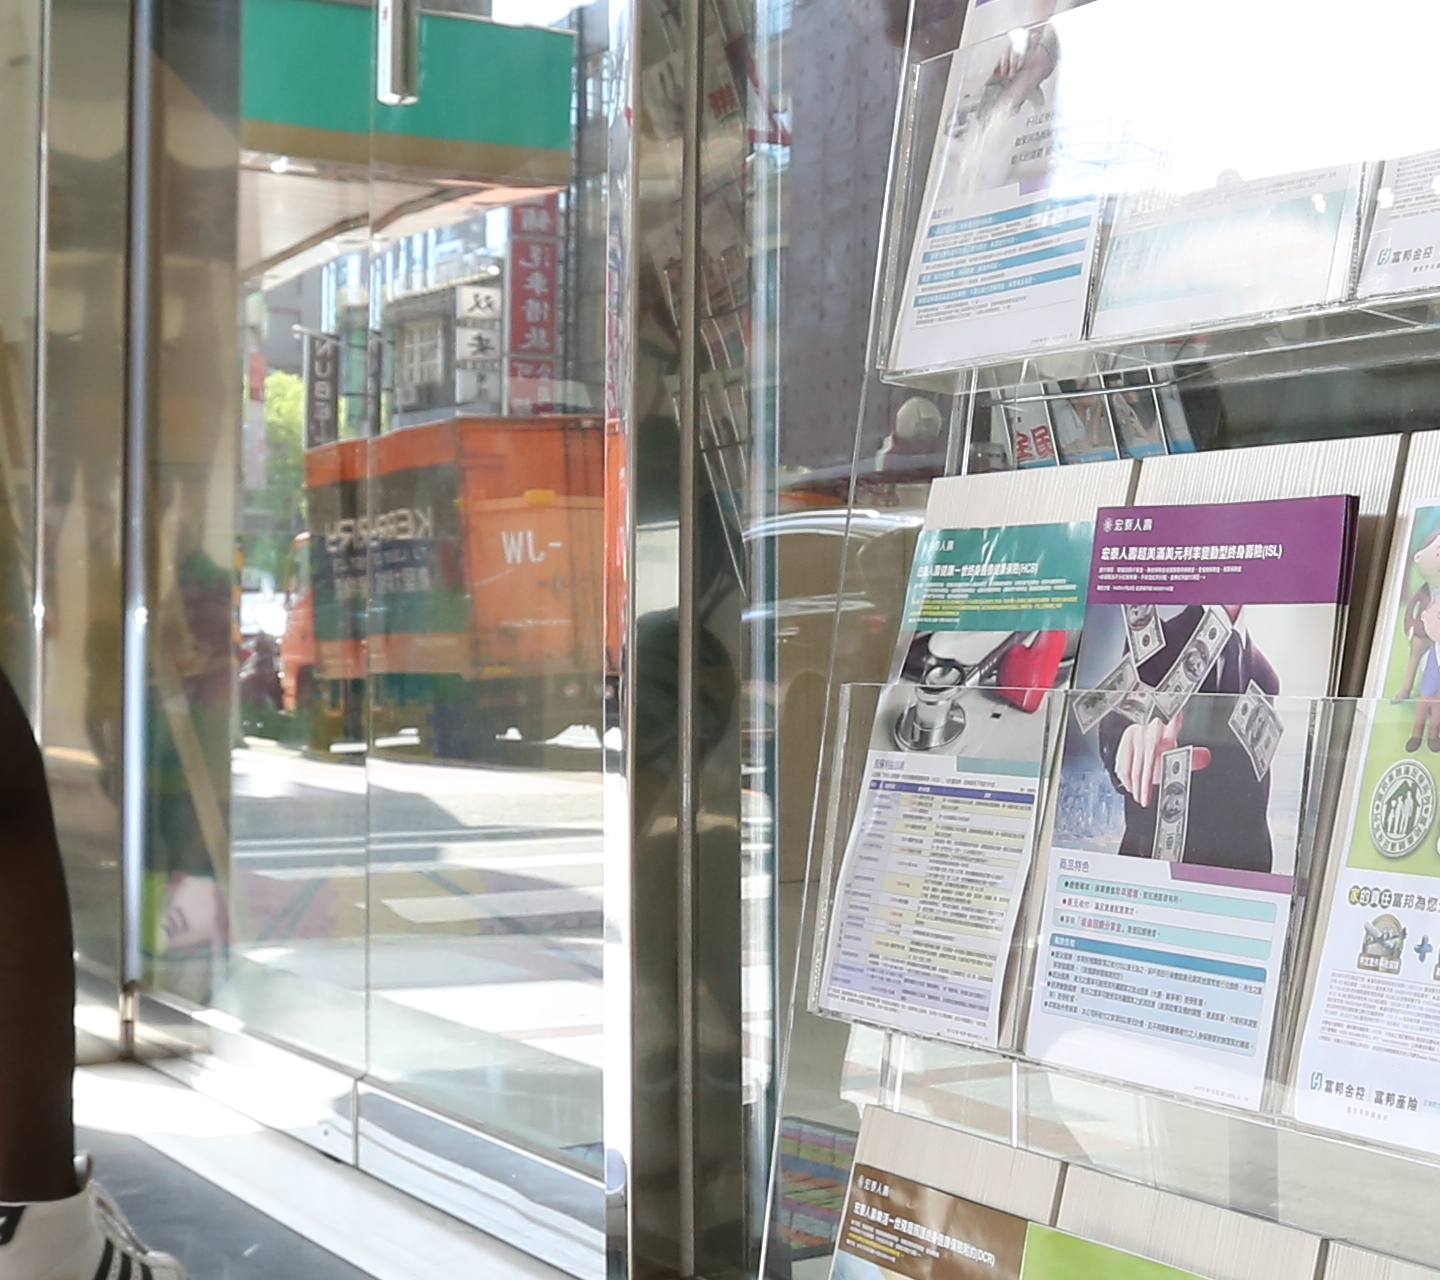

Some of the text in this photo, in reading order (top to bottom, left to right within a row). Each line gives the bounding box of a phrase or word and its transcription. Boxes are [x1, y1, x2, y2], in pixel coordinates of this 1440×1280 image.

[1391, 247, 1433, 263] 富邦金控
[1114, 515, 1152, 532] 宏泰人壽
[1324, 1076, 1418, 1112] 富邦金控 富邦產險
